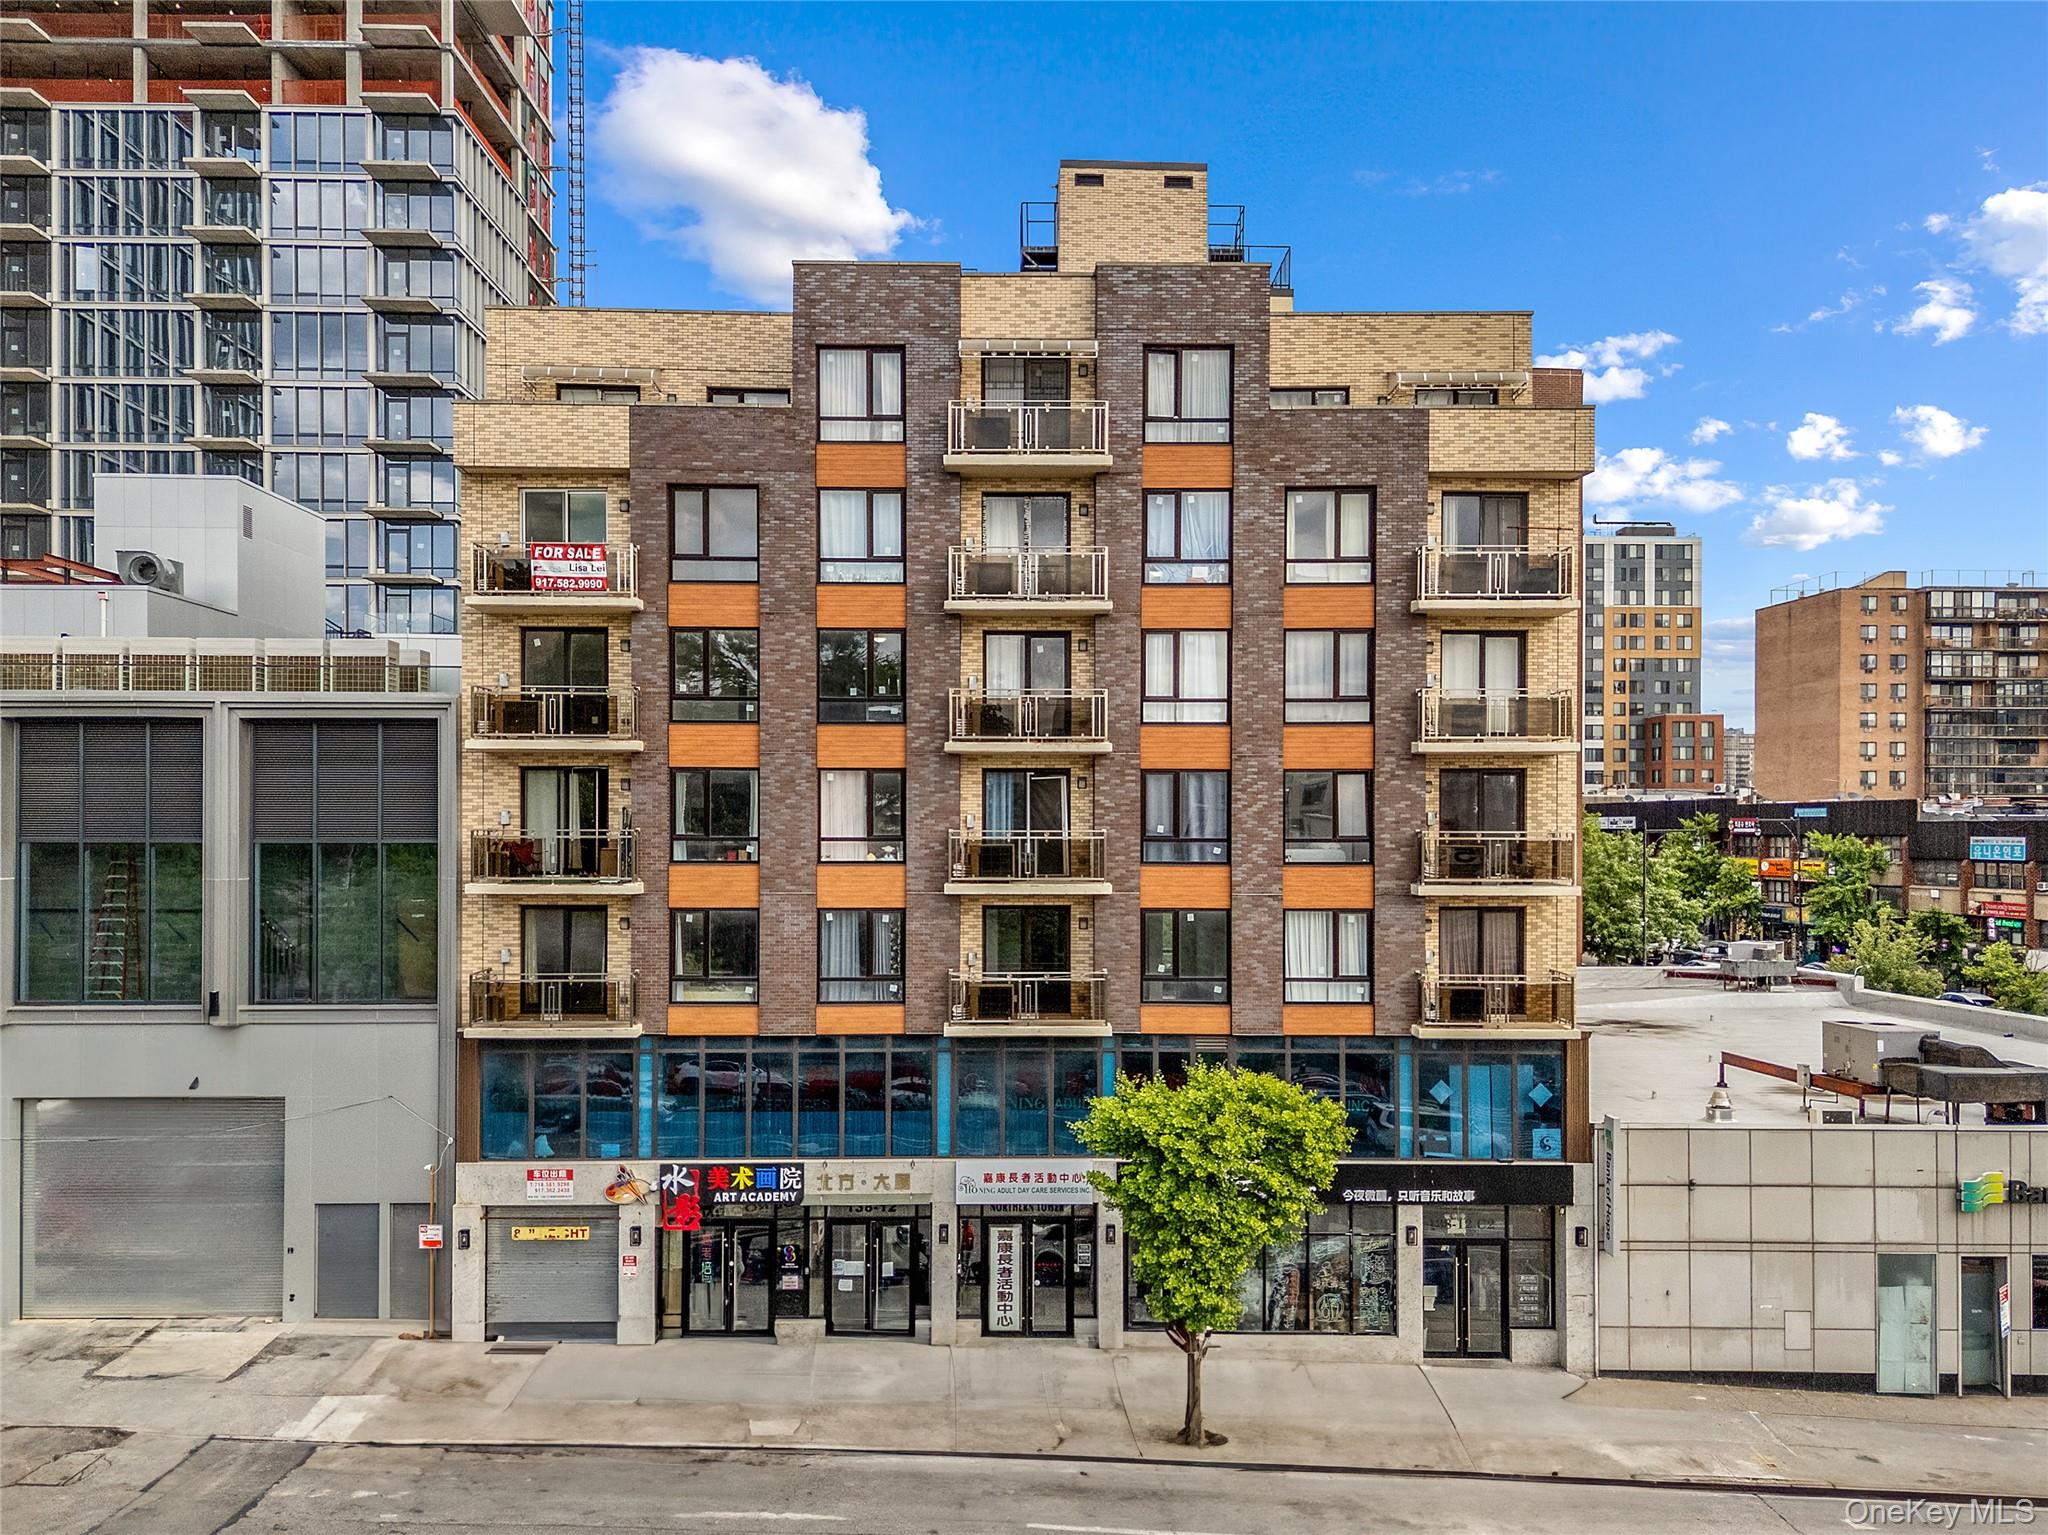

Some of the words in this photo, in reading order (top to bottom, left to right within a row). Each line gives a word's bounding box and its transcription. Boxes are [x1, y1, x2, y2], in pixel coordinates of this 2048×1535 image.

[535, 547, 563, 559] FOR
[567, 547, 602, 560] SALE
[570, 563, 588, 572] Lisa
[591, 563, 606, 572] Lei
[535, 578, 603, 589] 917.582.9990
[708, 1165, 802, 1190] 美术画院
[713, 1192, 739, 1203] ART
[740, 1191, 797, 1203] ACADEMY
[997, 1230, 1013, 1327] 嘉康長者活動中心
